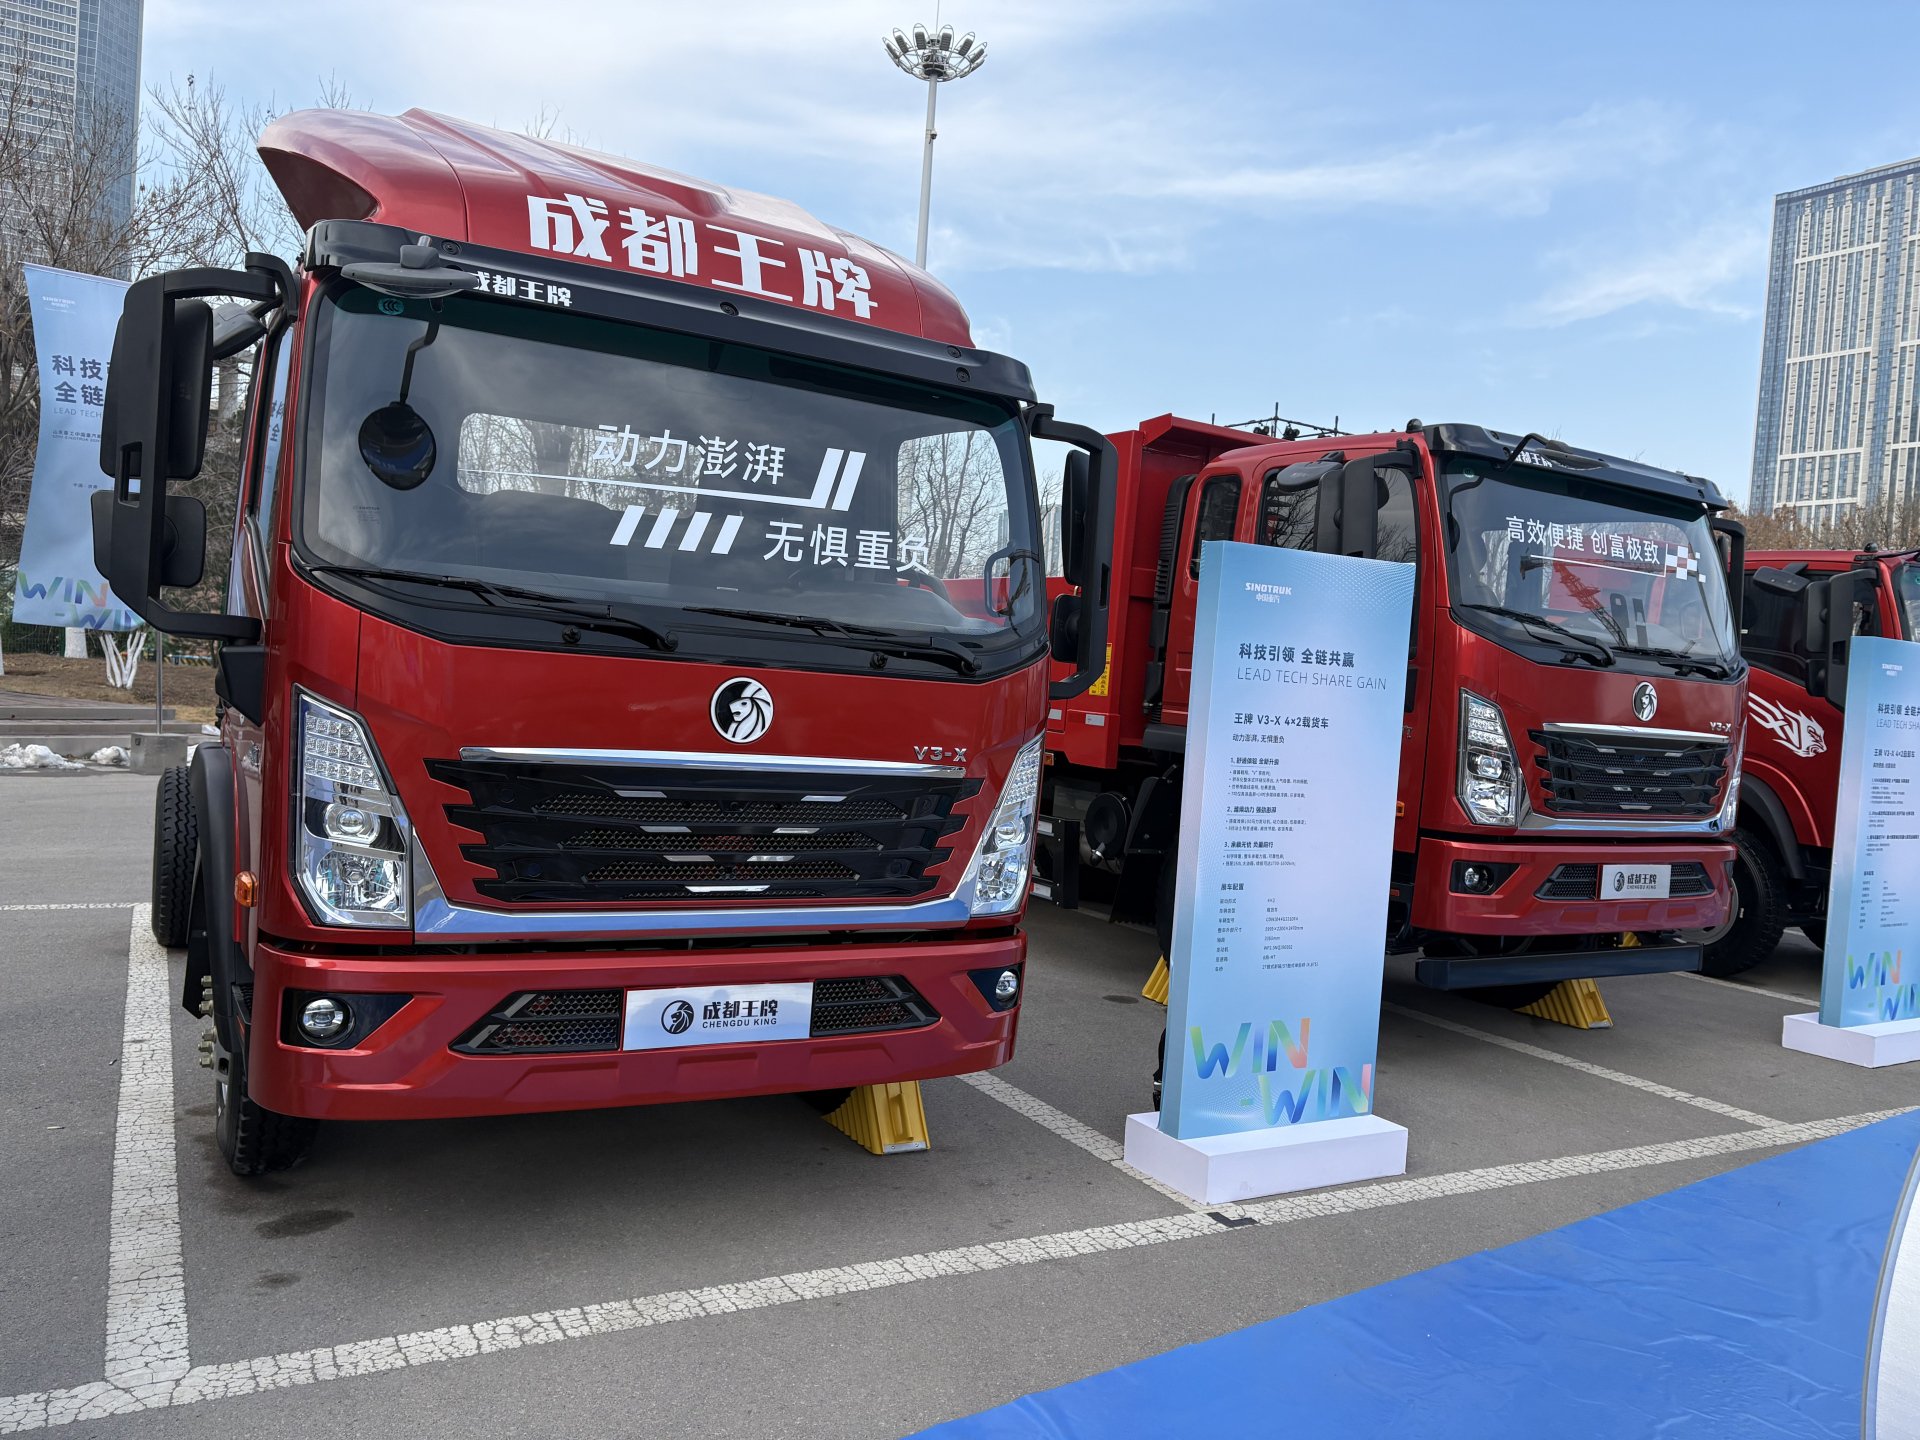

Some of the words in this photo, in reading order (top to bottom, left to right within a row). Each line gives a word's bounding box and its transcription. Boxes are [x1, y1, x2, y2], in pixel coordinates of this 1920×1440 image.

[527, 193, 878, 319] 成都王牌
[52, 355, 110, 381] 科技
[53, 408, 77, 416] LEAD
[593, 425, 785, 485] 动力澎湃
[763, 520, 931, 574] 无惧重负
[1506, 516, 1585, 551] 高效便捷
[1590, 529, 1661, 565] 创富极致
[18, 570, 109, 608] WIN
[1245, 582, 1292, 595] SINOTRUK
[1239, 642, 1296, 663] 科技引领
[1300, 647, 1355, 668] 全链共赢
[1237, 667, 1271, 682] LEAD
[1276, 669, 1308, 685] TECH
[1311, 672, 1353, 688] SHARE
[1357, 676, 1387, 690] GAIN
[1234, 712, 1254, 725] 王牌
[1257, 714, 1282, 726] V3-X
[1710, 721, 1732, 733] V3-X
[914, 746, 967, 762] V3-X
[1627, 873, 1657, 885] 成都王牌
[1848, 949, 1902, 989] WIN
[702, 999, 778, 1021] 成都王牌
[702, 1018, 750, 1029] CHENGDU
[753, 1017, 777, 1027] KING
[1190, 1017, 1311, 1080] WIN
